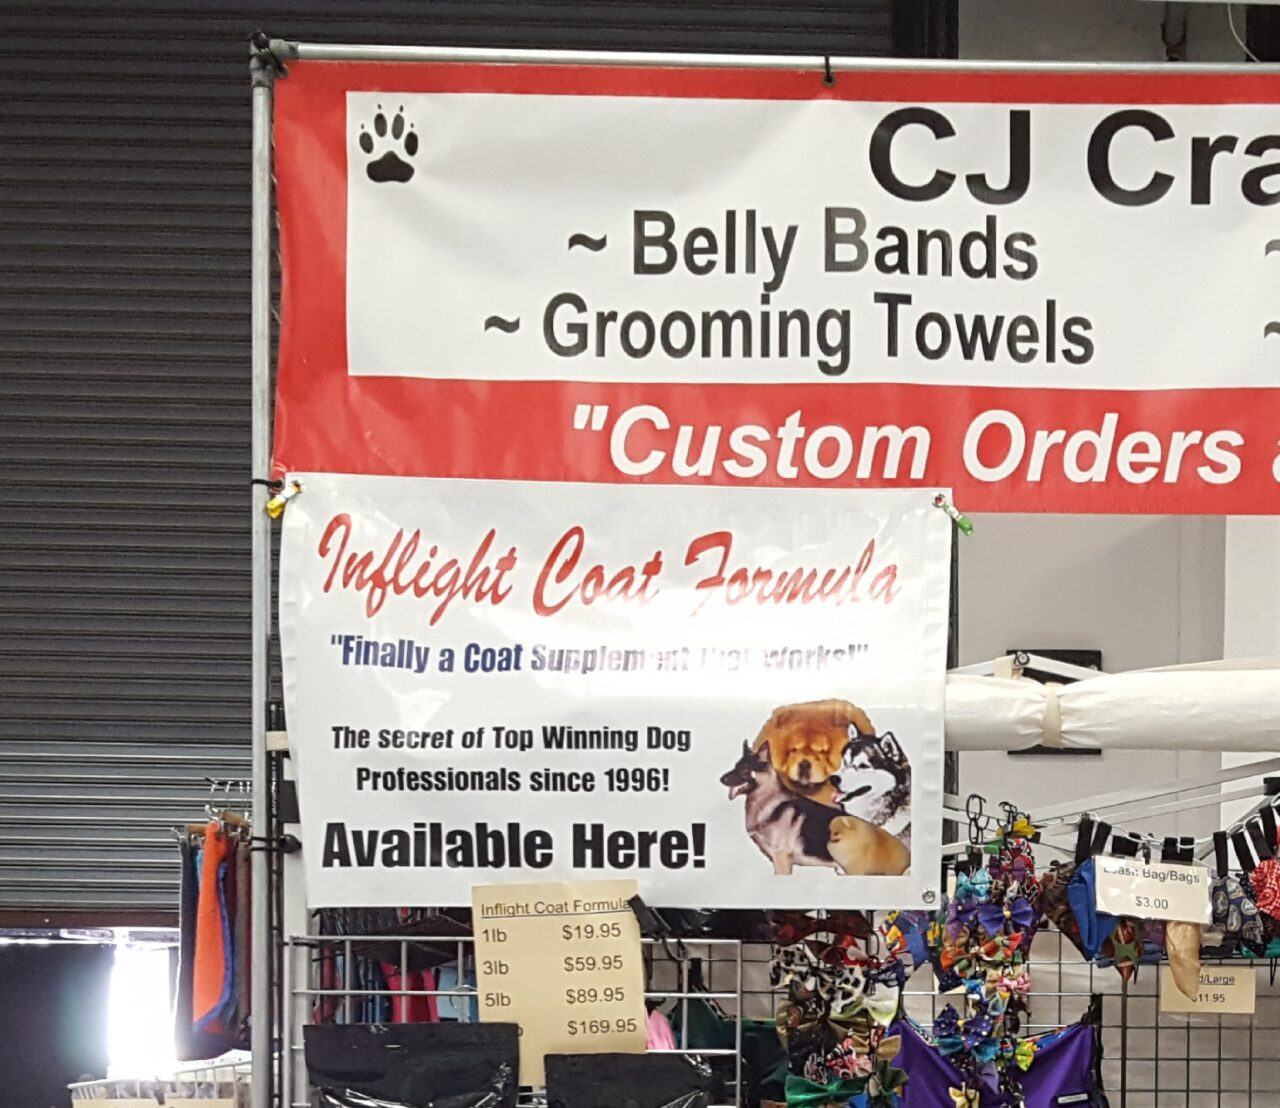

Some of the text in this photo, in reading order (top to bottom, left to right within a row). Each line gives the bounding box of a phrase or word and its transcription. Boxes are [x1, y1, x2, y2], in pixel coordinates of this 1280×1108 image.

[868, 107, 1032, 206] CJ
[632, 206, 1039, 291] Belly Bands
[542, 291, 1096, 376] Grooming Towels
[572, 403, 930, 480] "Custom
[962, 409, 1245, 485] Orders
[317, 512, 902, 627] Inflight Coat Formula
[330, 634, 431, 674] "Finally
[438, 647, 455, 673] a
[463, 642, 524, 674] Coat
[530, 643, 691, 675] Supplemnt
[331, 725, 692, 752] The secret of Top Winning Dog
[356, 767, 670, 793] Professionals since 1996!
[321, 822, 706, 870] Available Here!
[1142, 867, 1200, 886] Bag/Bags
[481, 897, 631, 917] Inflight Coat Formula
[1135, 895, 1169, 910] $3.00
[482, 922, 622, 943] 1lb $19.95
[483, 954, 623, 976] 3lb $59.95
[485, 987, 625, 1007] 5lb $89.95
[1192, 993, 1226, 1003] 11.95
[567, 1018, 638, 1036] $169.95
